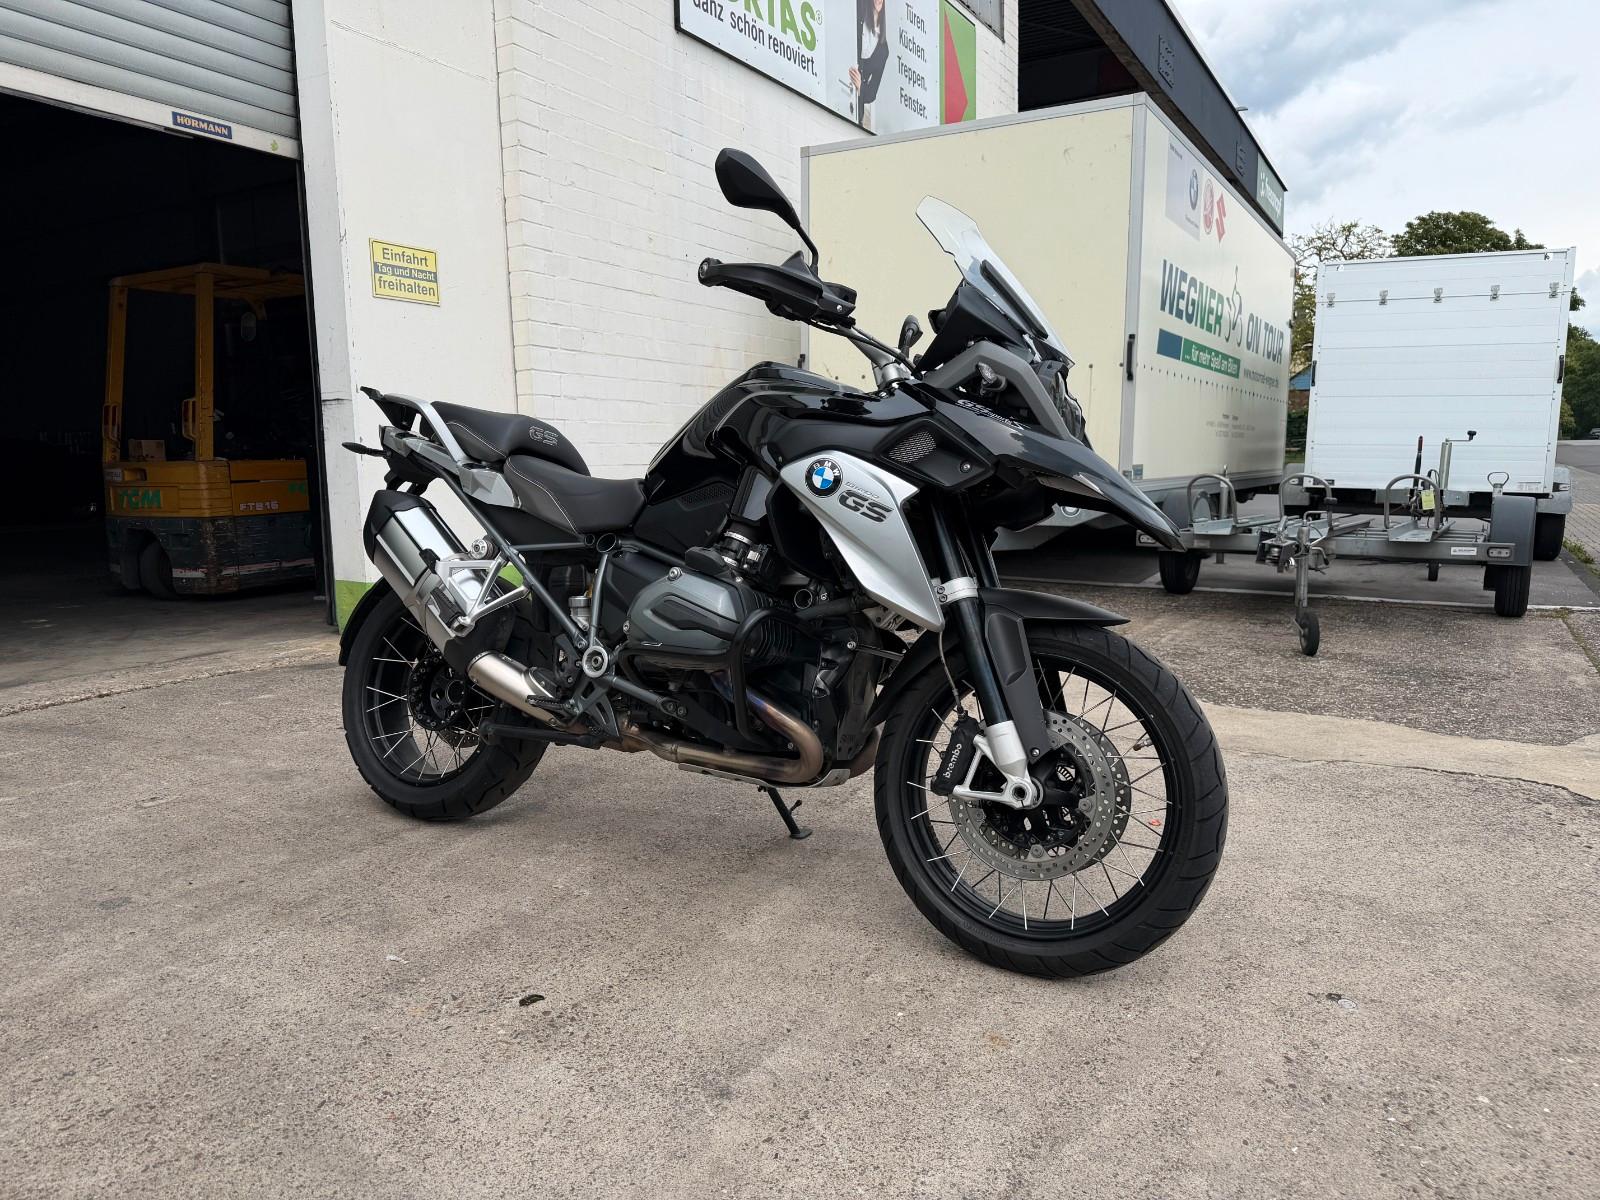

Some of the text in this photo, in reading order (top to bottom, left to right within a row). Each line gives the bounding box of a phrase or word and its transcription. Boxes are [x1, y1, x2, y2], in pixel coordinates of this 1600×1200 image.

[905, 3, 927, 34] Türen.
[730, 11, 765, 46] schön
[768, 33, 818, 77] renoviert.
[899, 27, 927, 63] Küchen.
[897, 55, 927, 92] Treppen.
[899, 86, 928, 120] Fenster.
[377, 262, 435, 281] Tag und Nacht
[382, 247, 429, 267] Einfahrt
[377, 276, 436, 297] freihalten
[1160, 259, 1284, 365] WEGNER ON TOUR
[529, 426, 559, 447] GS
[812, 460, 841, 477] BMW
[837, 489, 895, 524] GS
[943, 743, 962, 779] brembo
